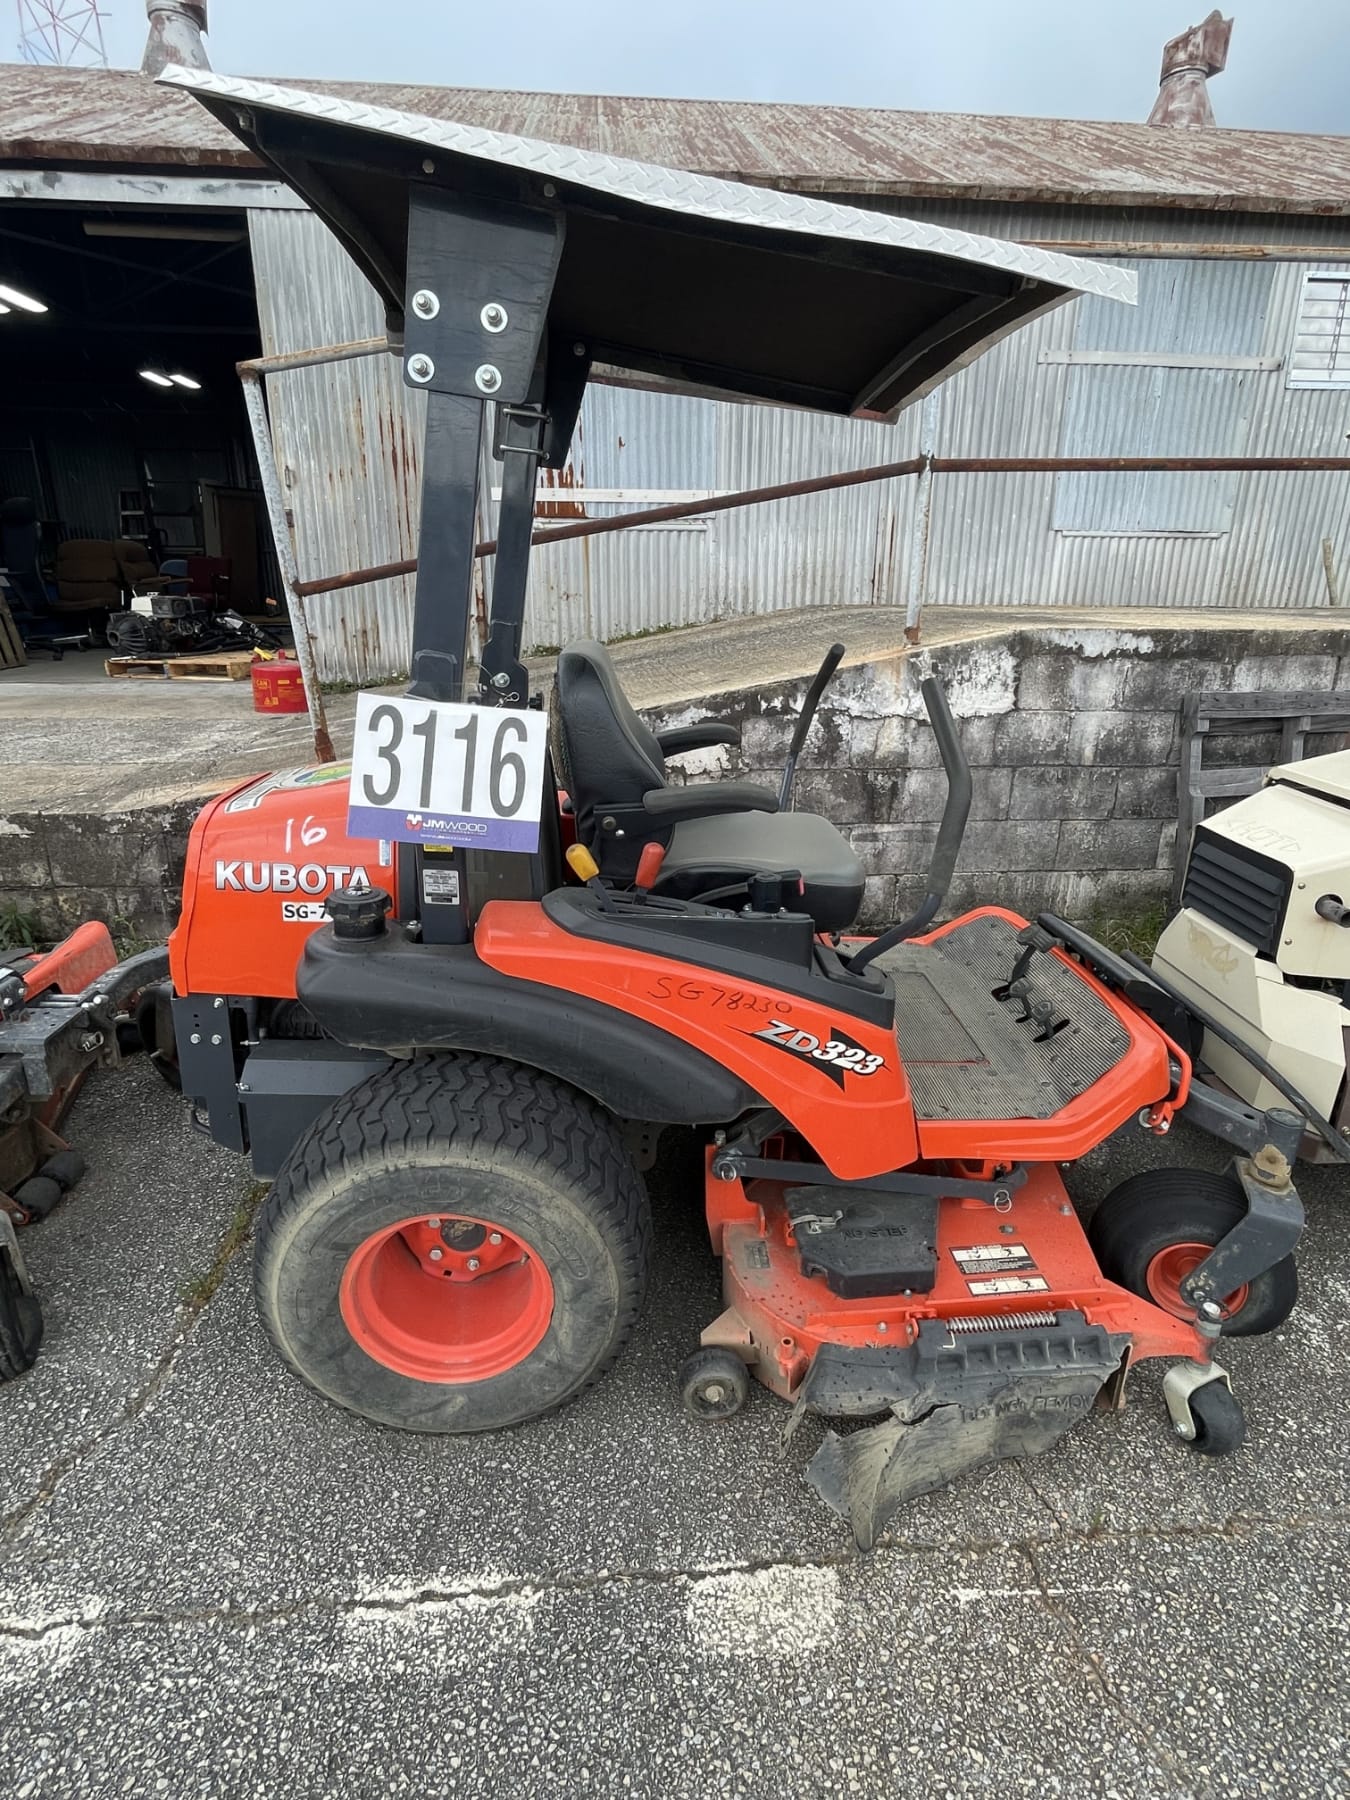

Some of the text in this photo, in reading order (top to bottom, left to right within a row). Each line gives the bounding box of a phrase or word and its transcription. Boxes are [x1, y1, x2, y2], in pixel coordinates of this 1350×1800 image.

[363, 704, 528, 817] 3116
[284, 815, 327, 853] 16
[215, 861, 371, 894] KUBOTA
[284, 904, 326, 919] SG-7
[755, 1019, 884, 1075] ZD323
[1032, 1393, 1093, 1411] REMOV
